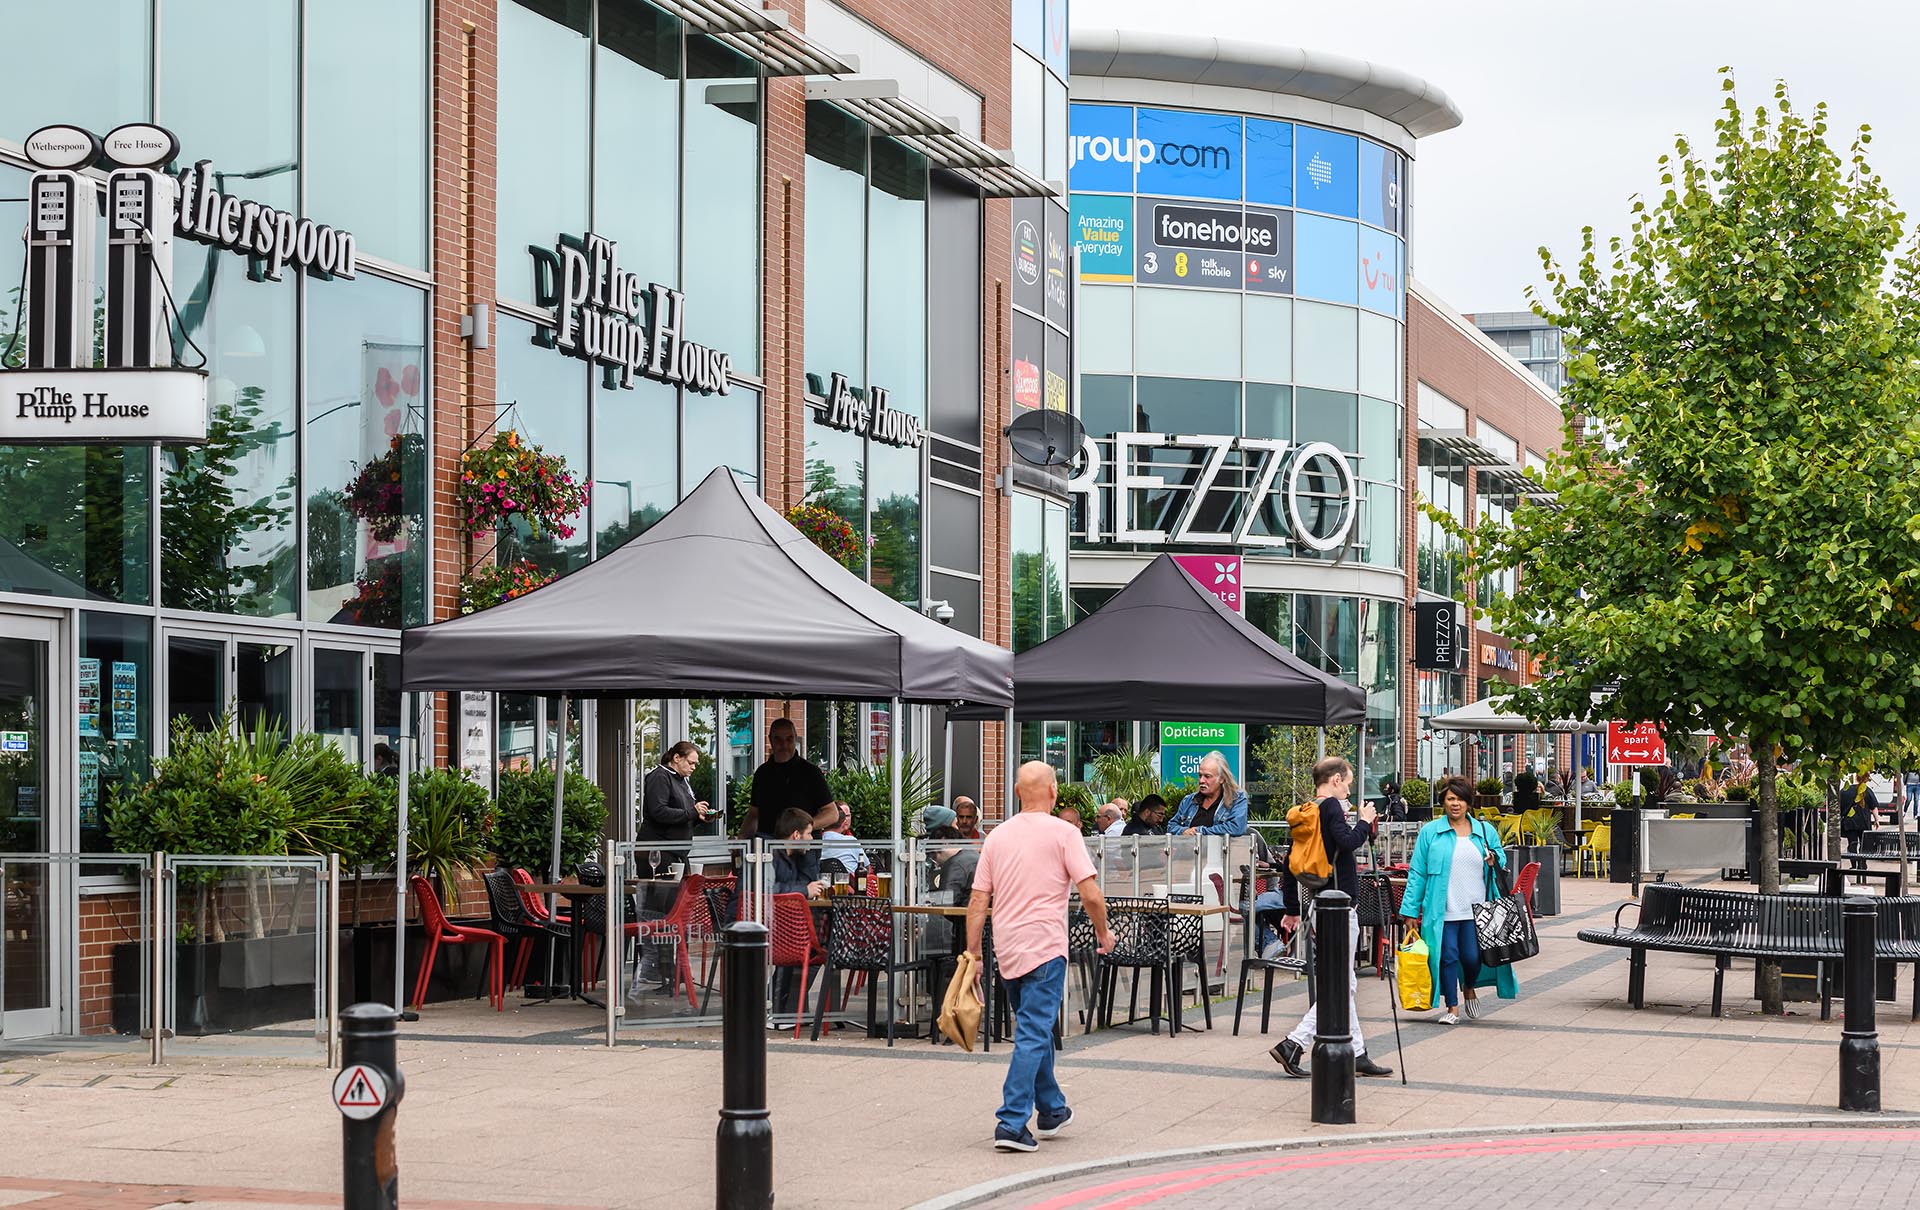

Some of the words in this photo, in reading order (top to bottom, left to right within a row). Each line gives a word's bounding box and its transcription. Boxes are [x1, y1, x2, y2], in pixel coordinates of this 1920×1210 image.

[31, 142, 85, 152] Wetherspoon
[114, 140, 132, 149] Free
[136, 140, 163, 149] House
[1078, 215, 1124, 231] Amazing
[1162, 214, 1272, 247] fonehouse
[1082, 228, 1120, 242] Value
[1075, 240, 1123, 256] Everyday
[1143, 252, 1159, 274] 3
[1201, 258, 1218, 268] talk
[584, 232, 641, 319] The
[1201, 266, 1232, 278] mobile
[1268, 266, 1287, 282] sky
[1382, 272, 1394, 292] TUI
[556, 243, 644, 390] Pump
[648, 282, 734, 397] House
[34, 387, 72, 405] The
[16, 393, 77, 423] Pump
[83, 393, 149, 418] House
[829, 372, 868, 433] Free
[871, 386, 923, 448] House
[1436, 608, 1450, 662] PREZZO
[1164, 726, 1225, 739] Opticians
[1624, 736, 1649, 744] apart
[636, 924, 682, 945] Pump
[653, 919, 679, 934] The
